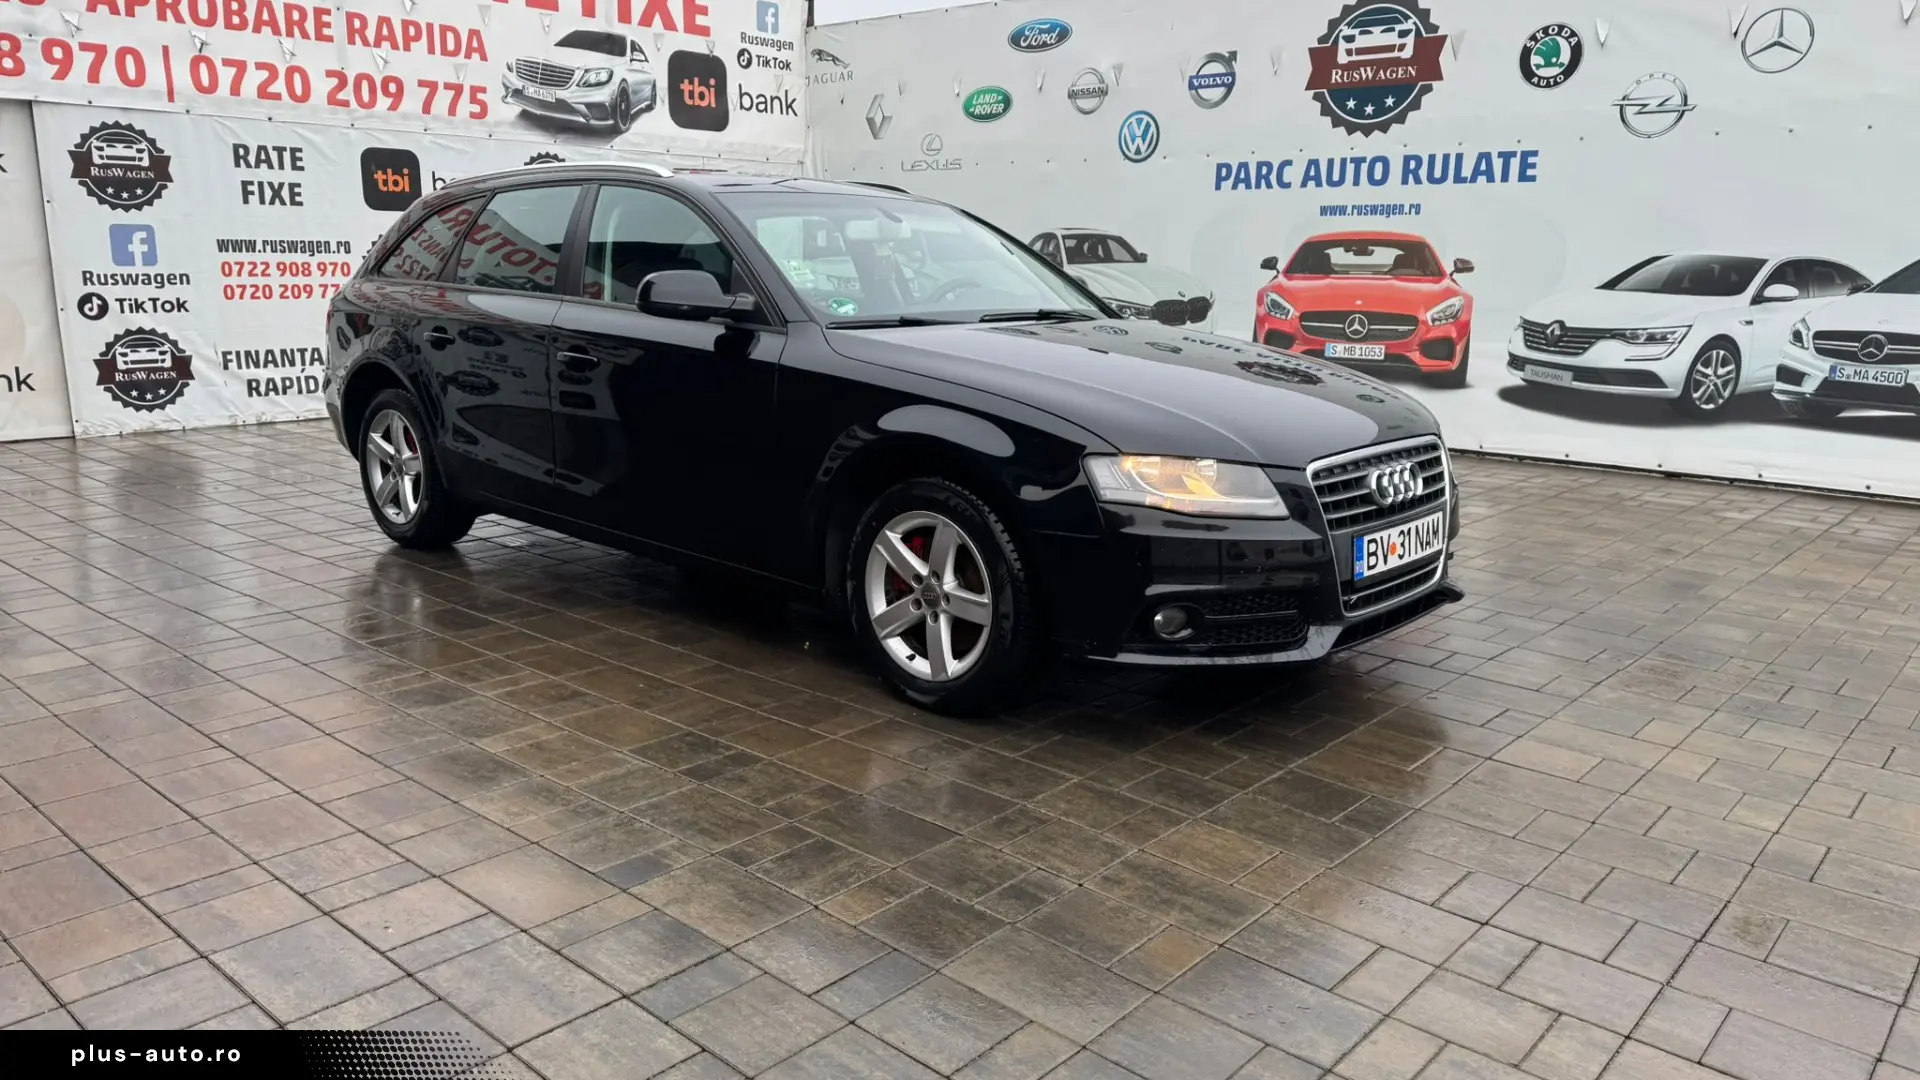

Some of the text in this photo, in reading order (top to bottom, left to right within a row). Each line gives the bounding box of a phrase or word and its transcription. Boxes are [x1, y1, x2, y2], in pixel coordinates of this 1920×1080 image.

[346, 10, 488, 62] RAPIDA
[740, 31, 794, 52] Ruswagen
[1022, 25, 1060, 46] Ford
[755, 54, 792, 71] TikTok
[41, 38, 147, 88] 970
[189, 54, 312, 103] 0720
[324, 70, 405, 111] 209
[417, 79, 488, 120] 775
[805, 70, 854, 88] JAGUAR
[1193, 74, 1232, 87] VOLVO
[1531, 74, 1565, 87] AUTO
[680, 77, 716, 108] tbi
[738, 83, 798, 117] bank
[972, 93, 997, 105] LAND
[1070, 87, 1105, 97] NISSAN
[974, 103, 1004, 115] ROVER
[232, 143, 305, 172] RATE
[901, 158, 963, 172] LEXUS
[1214, 149, 1539, 191] PARC AUTO RULATE
[373, 168, 410, 193] tbi
[240, 180, 304, 207] FIXE
[1319, 202, 1422, 219] www.ruswagen.ro
[216, 238, 352, 257] www.ruswagen.ro
[220, 261, 351, 278] 0722 908 970
[81, 270, 191, 289] Ruswagen
[223, 283, 341, 300] 0720 209 77
[114, 297, 190, 314] TikTok
[1331, 345, 1383, 358] S MB 1053
[1837, 367, 1904, 385] S MA 4500
[246, 375, 322, 398] RAPID
[1366, 516, 1440, 571] BV 31 NAM
